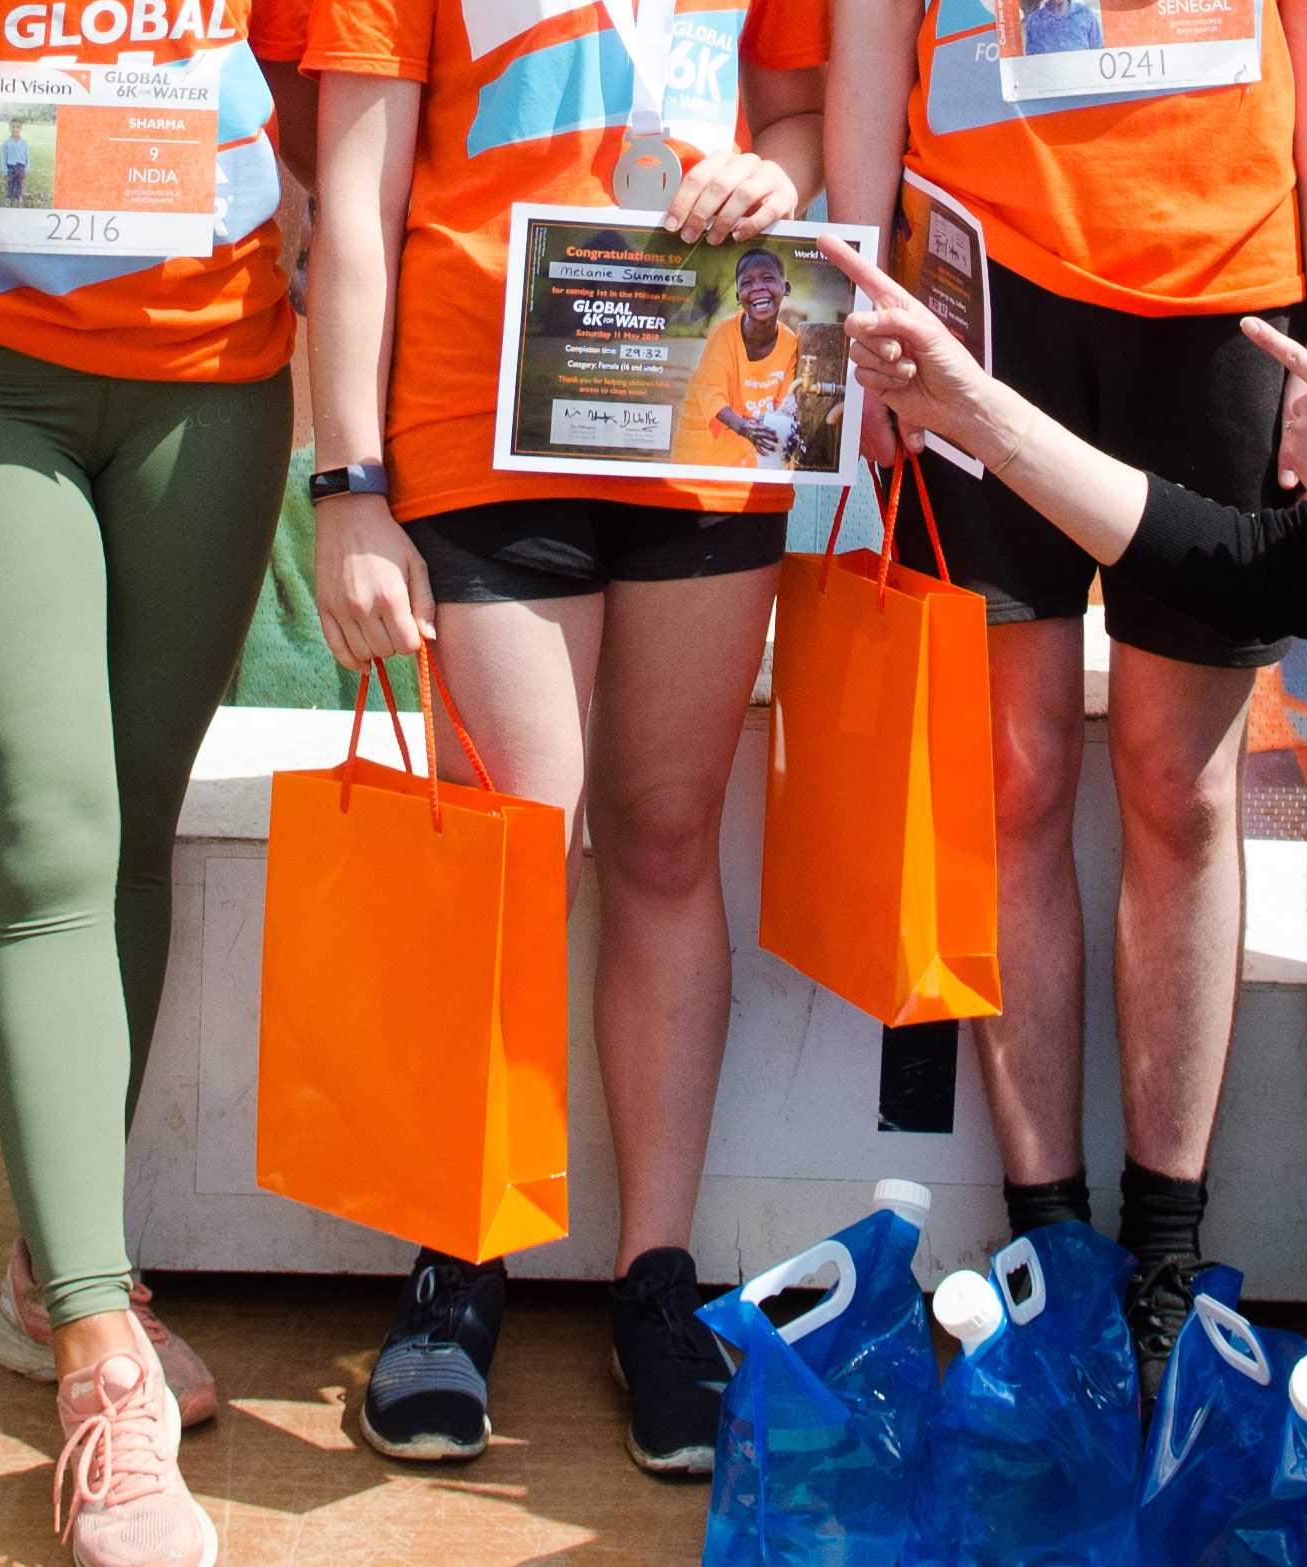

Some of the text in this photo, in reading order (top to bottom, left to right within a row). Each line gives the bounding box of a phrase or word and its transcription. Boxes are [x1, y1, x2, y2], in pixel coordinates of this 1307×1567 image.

[1098, 49, 1167, 81] 0241
[104, 70, 172, 86] GLOBAL
[21, 79, 72, 96] Vision
[116, 85, 137, 99] 6K
[153, 86, 209, 101] WATER
[128, 117, 186, 130] SHARMA
[149, 146, 159, 161] 9
[128, 167, 178, 184] INDIA
[46, 213, 120, 243] 2216
[566, 246, 683, 263] Congratulations to
[794, 250, 818, 259] World
[560, 266, 684, 283] Melanie Summers
[573, 300, 632, 315] GLOBAL
[583, 314, 603, 327] 6K
[616, 315, 665, 330] WATER
